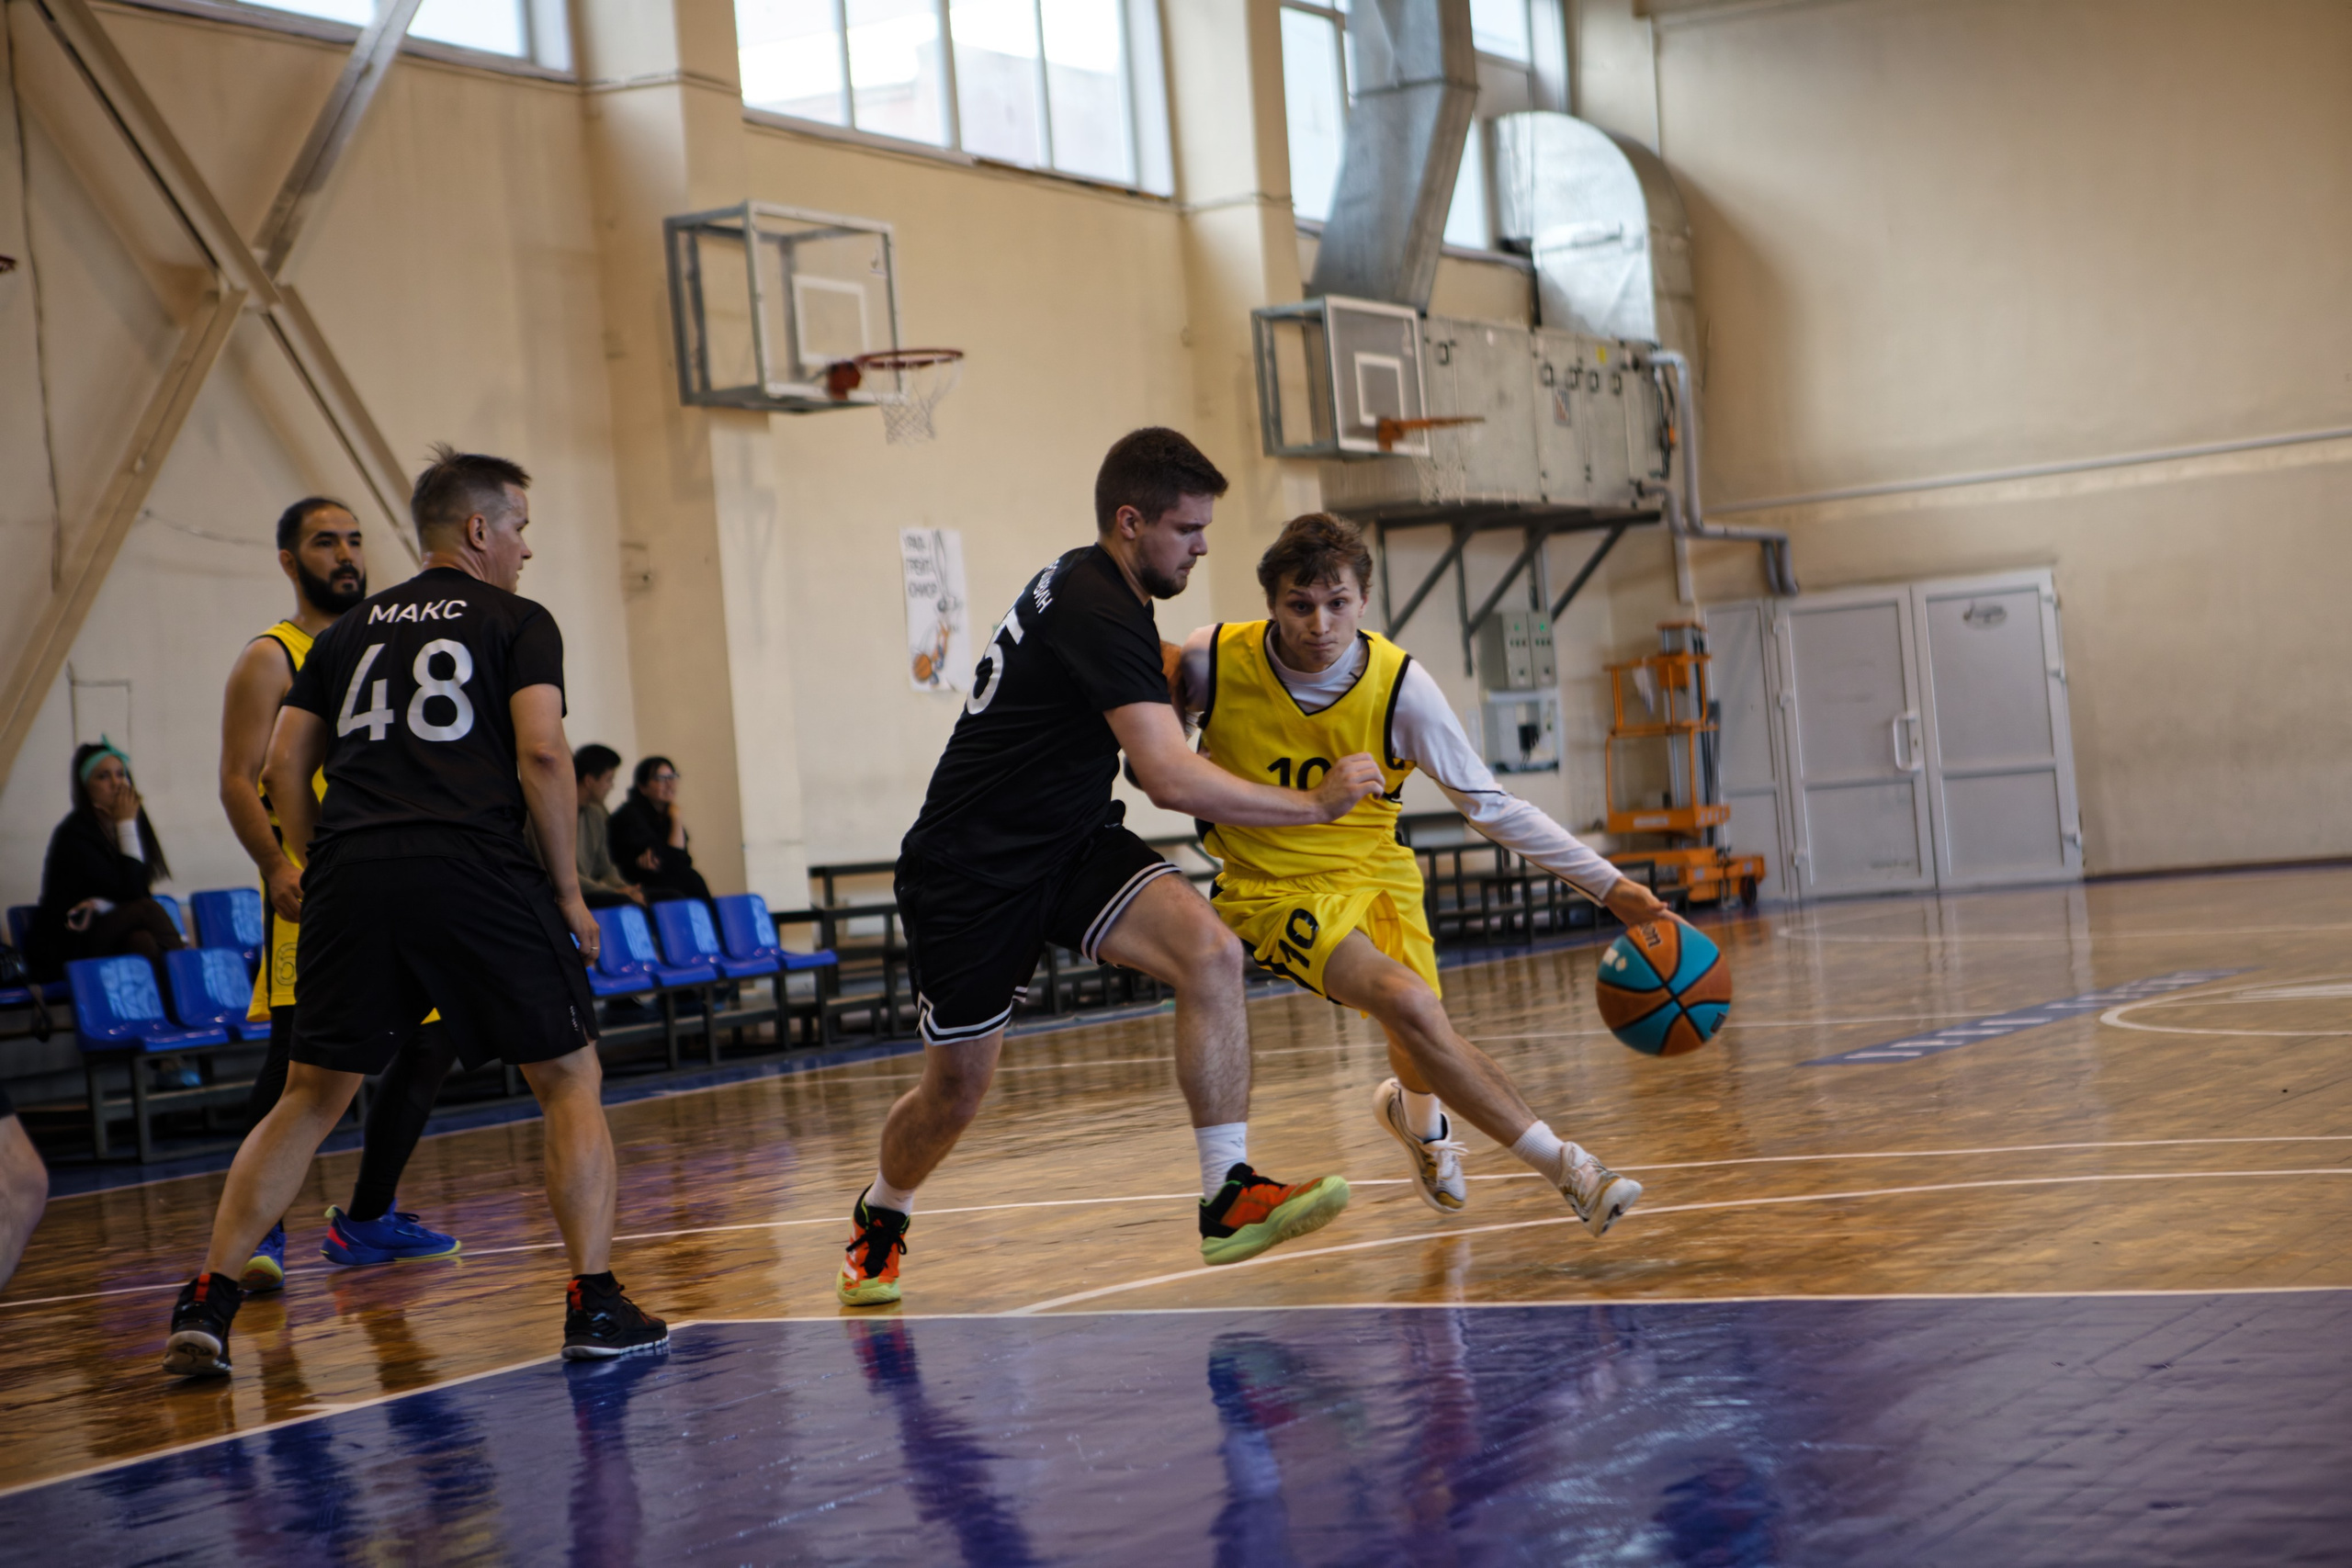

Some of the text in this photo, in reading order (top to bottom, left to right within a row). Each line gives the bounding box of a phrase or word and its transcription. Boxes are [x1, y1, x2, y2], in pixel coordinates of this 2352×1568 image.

[368, 599, 468, 626] МАКС
[336, 637, 474, 742] 48
[1278, 908, 1320, 970] 10
